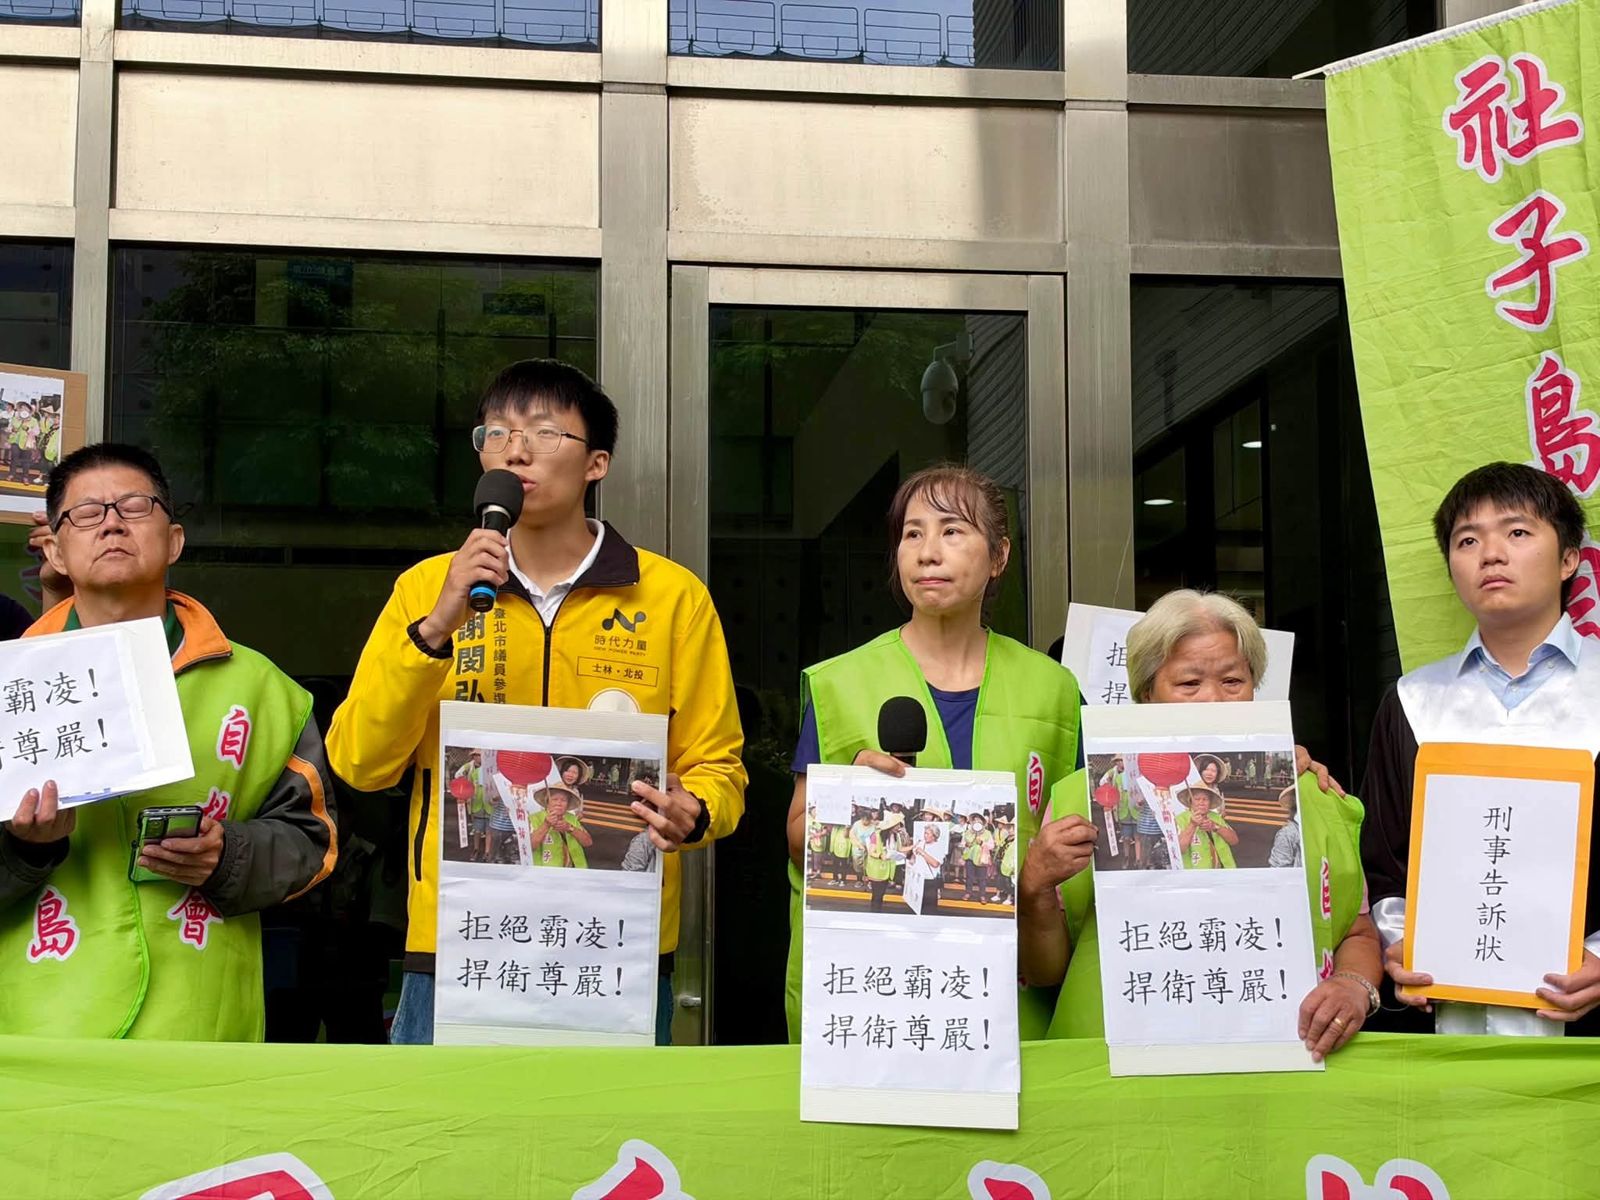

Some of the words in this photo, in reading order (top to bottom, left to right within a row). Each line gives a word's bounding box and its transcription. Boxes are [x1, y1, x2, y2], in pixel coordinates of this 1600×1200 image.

[594, 634, 647, 651] 時代力量
[3, 667, 100, 716] 霸凌！
[1101, 680, 1128, 705] 捍
[0, 718, 109, 771] 尊嚴！
[1473, 805, 1513, 962] 刑事告訴狀
[27, 886, 81, 962] 島
[458, 910, 625, 949] 拒絕霸凌！
[1118, 916, 1283, 952] 拒絕霸凌！
[456, 957, 624, 997] 捍衛尊嚴！
[822, 962, 989, 1000] 拒絕霸凌！
[1121, 967, 1288, 1005] 捍衛尊嚴！
[822, 1013, 990, 1051] 捍衛尊嚴！
